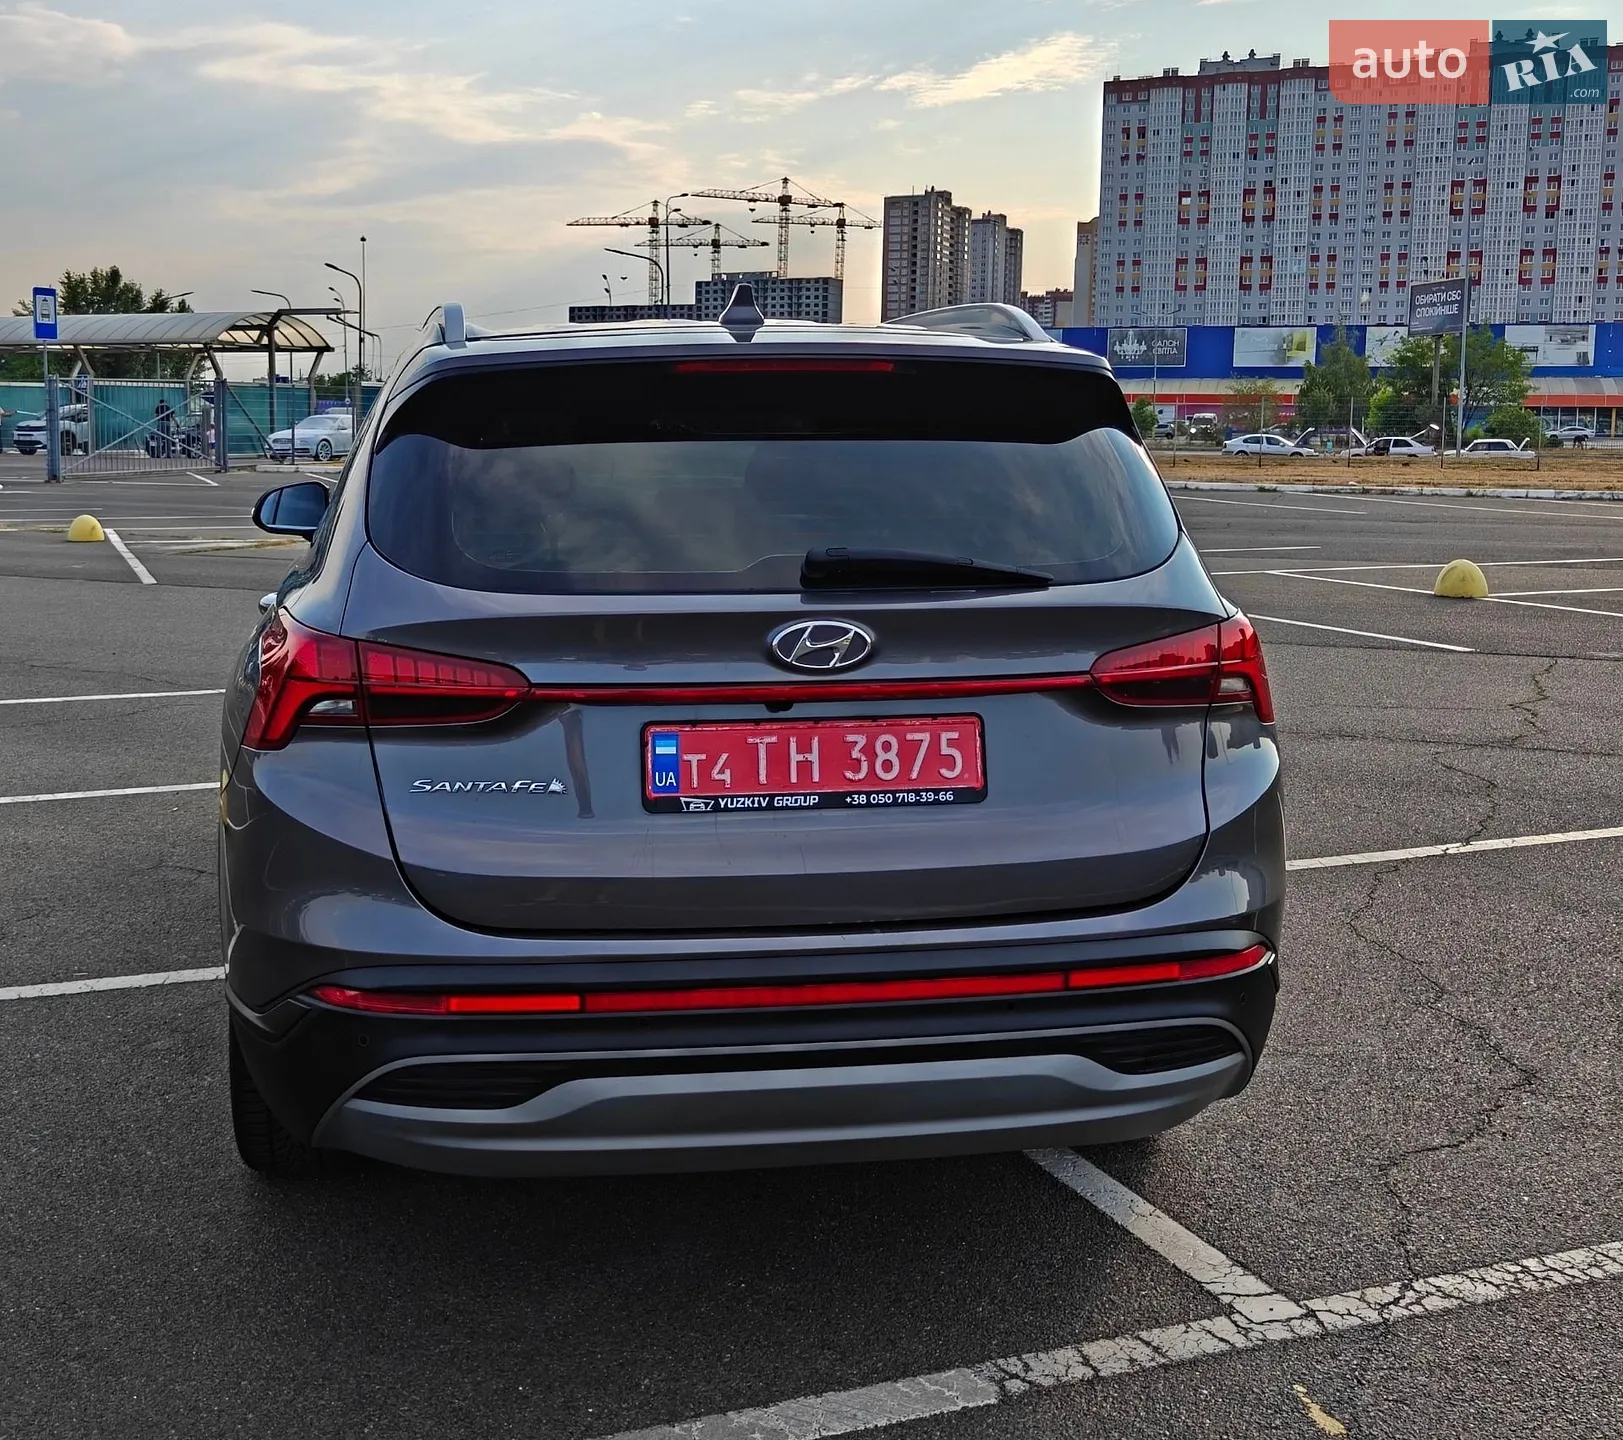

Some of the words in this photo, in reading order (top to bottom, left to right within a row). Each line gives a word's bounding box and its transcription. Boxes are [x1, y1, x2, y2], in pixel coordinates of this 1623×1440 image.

[1415, 292, 1446, 305] ОБИРАТИ
[1447, 290, 1461, 301] СБС
[1415, 304, 1459, 318] СПОКІЙНІШЕ
[1152, 339, 1180, 347] САЛОН
[682, 753, 731, 788] T4
[746, 735, 819, 784] TH
[843, 731, 963, 781] 3875
[656, 772, 677, 787] UA
[718, 796, 770, 809] YUZKIV
[774, 795, 819, 807] GROUP
[845, 794, 867, 805] +38
[870, 794, 893, 804] 050
[895, 791, 954, 804] 718-39-66
